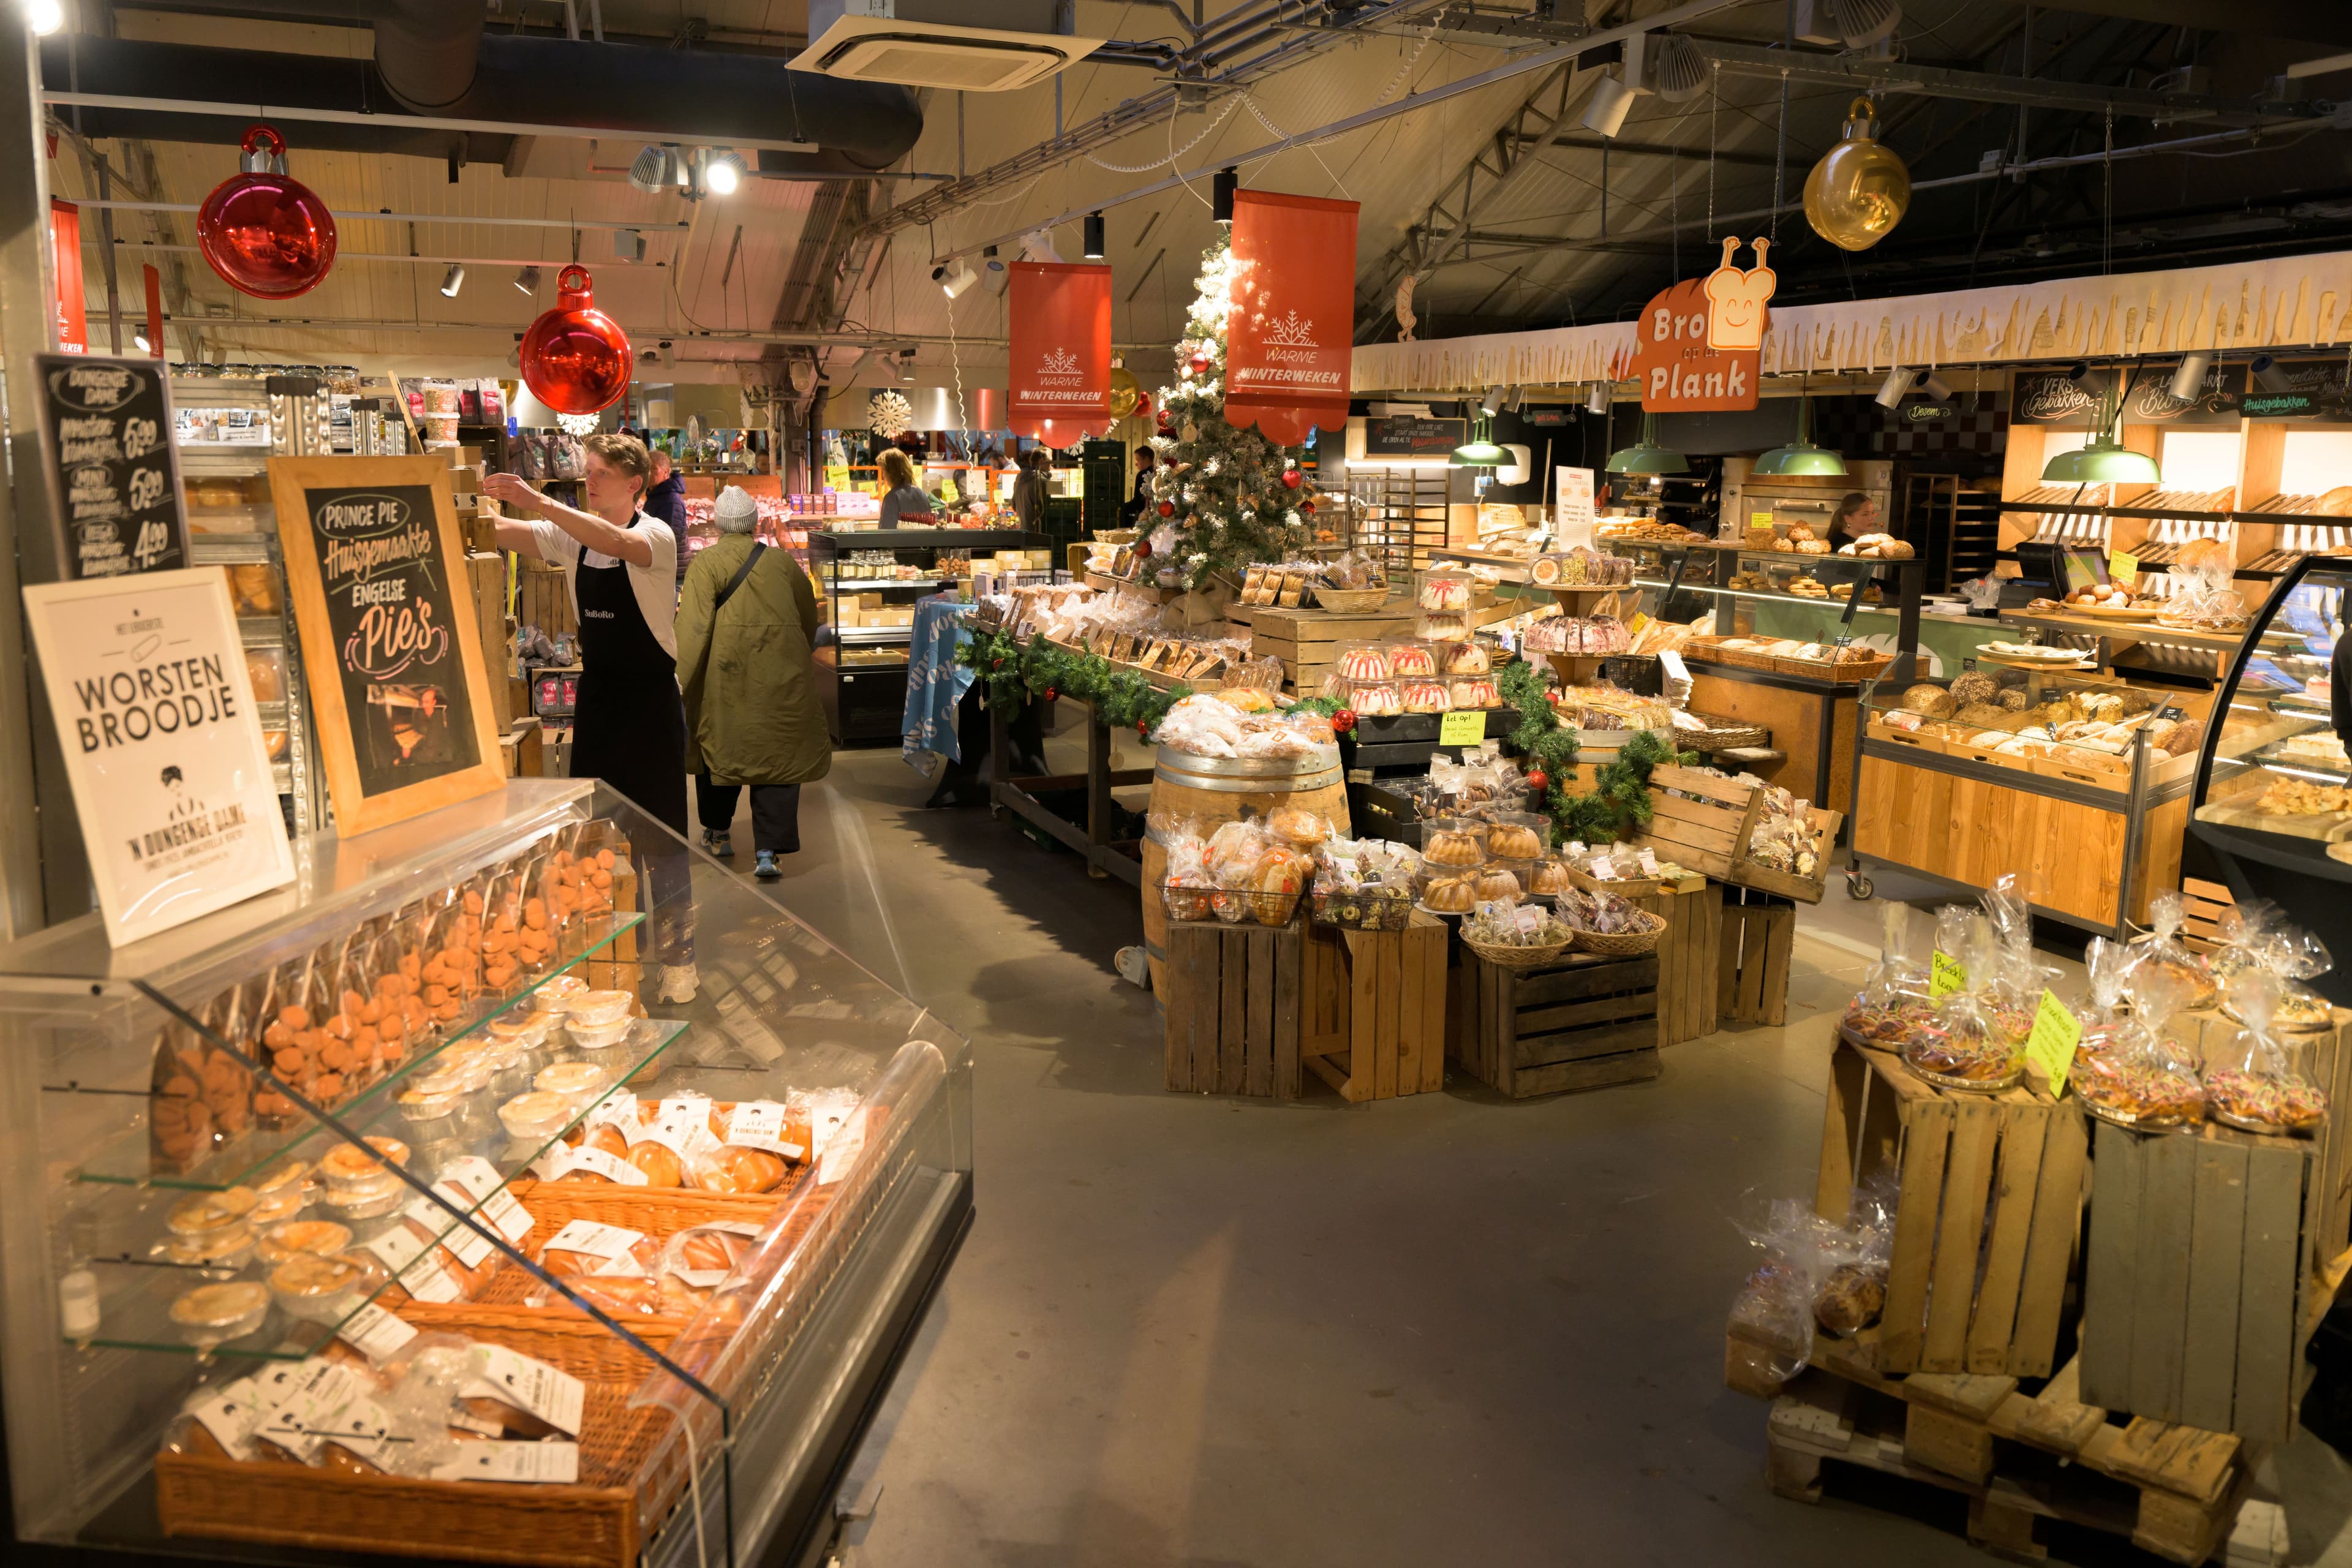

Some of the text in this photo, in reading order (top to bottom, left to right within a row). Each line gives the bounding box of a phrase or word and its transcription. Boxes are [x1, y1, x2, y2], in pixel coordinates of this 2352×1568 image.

[1266, 349, 1317, 363] WARME
[1682, 347, 1698, 364] op
[1040, 377, 1083, 386] WARME
[1238, 368, 1341, 384] WINTERWEKEN
[1650, 360, 1746, 399] Plank
[2043, 377, 2073, 395] VERS
[1020, 391, 1102, 401] WINTERWEKEN
[2022, 391, 2094, 418] Gebakken
[2244, 396, 2310, 412] Huisgebakken
[1911, 405, 1940, 417] Desem
[325, 502, 398, 529] PRINCE PIE
[323, 522, 432, 584] Huisgemaakte
[352, 578, 407, 607] ENGELSE
[359, 596, 431, 668] Pie's
[75, 654, 224, 712] WORSTEN
[76, 685, 236, 753] BROODJE
